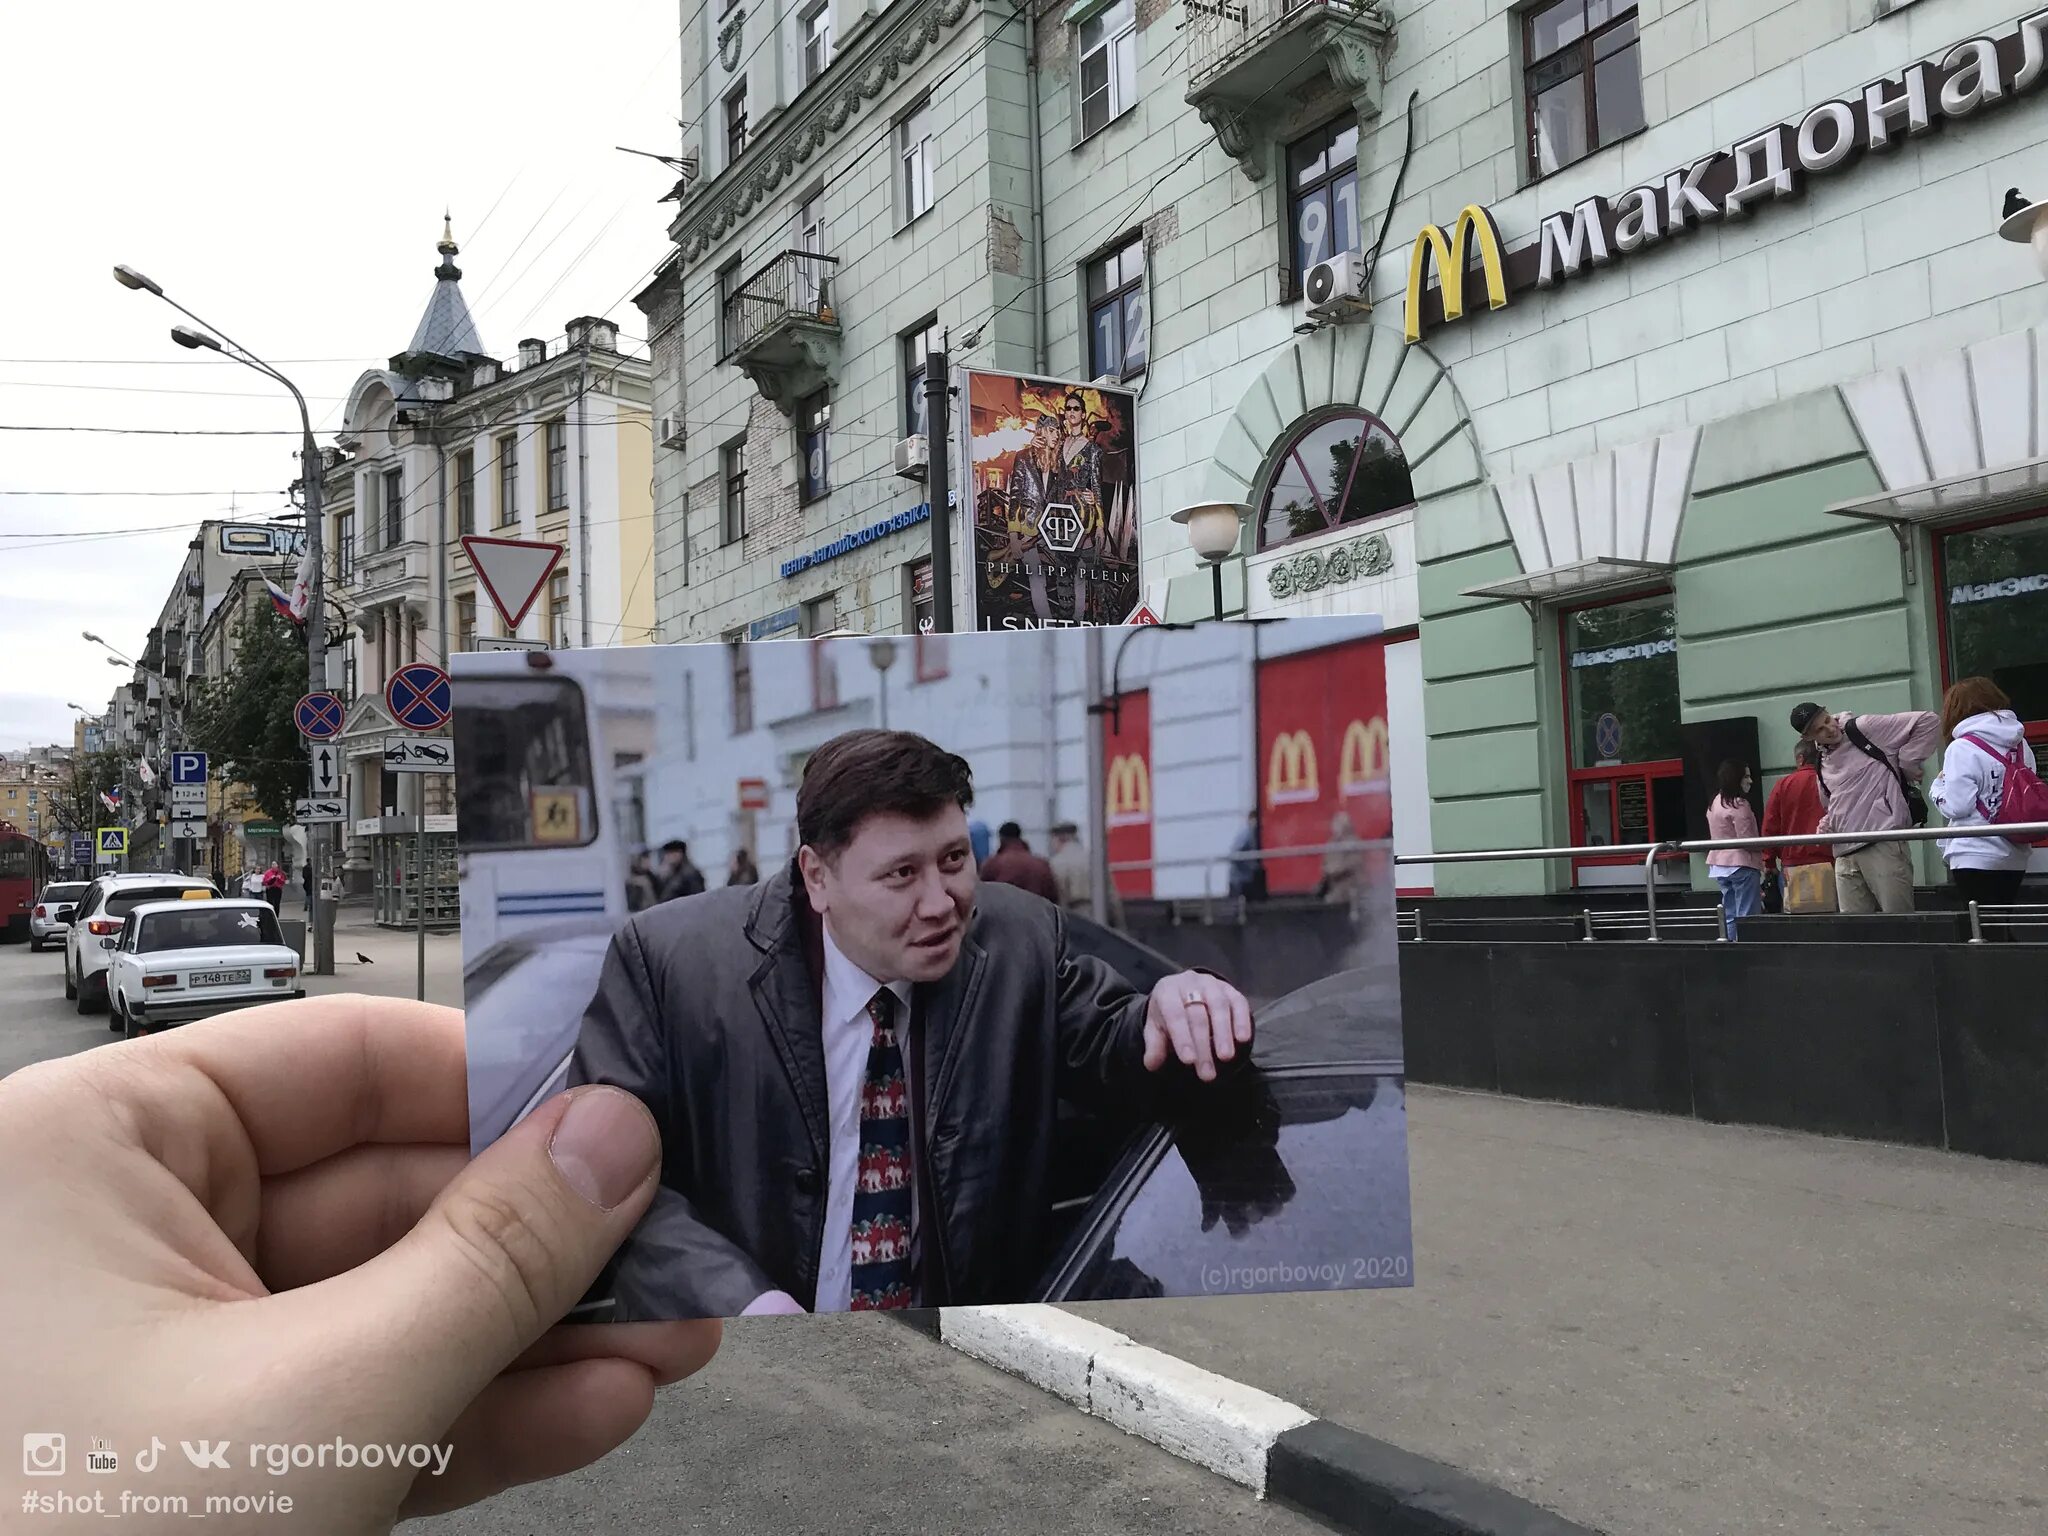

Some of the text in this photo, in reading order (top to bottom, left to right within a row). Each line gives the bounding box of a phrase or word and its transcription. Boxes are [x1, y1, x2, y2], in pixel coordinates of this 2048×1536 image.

[780, 502, 930, 578] ЦЕНТР АНГЛИЙСКОГО ЯЗЫКА
[987, 562, 1130, 583] PHILIPP PLEIN
[1200, 1255, 1408, 1291] (c)rgorbovoy 2020
